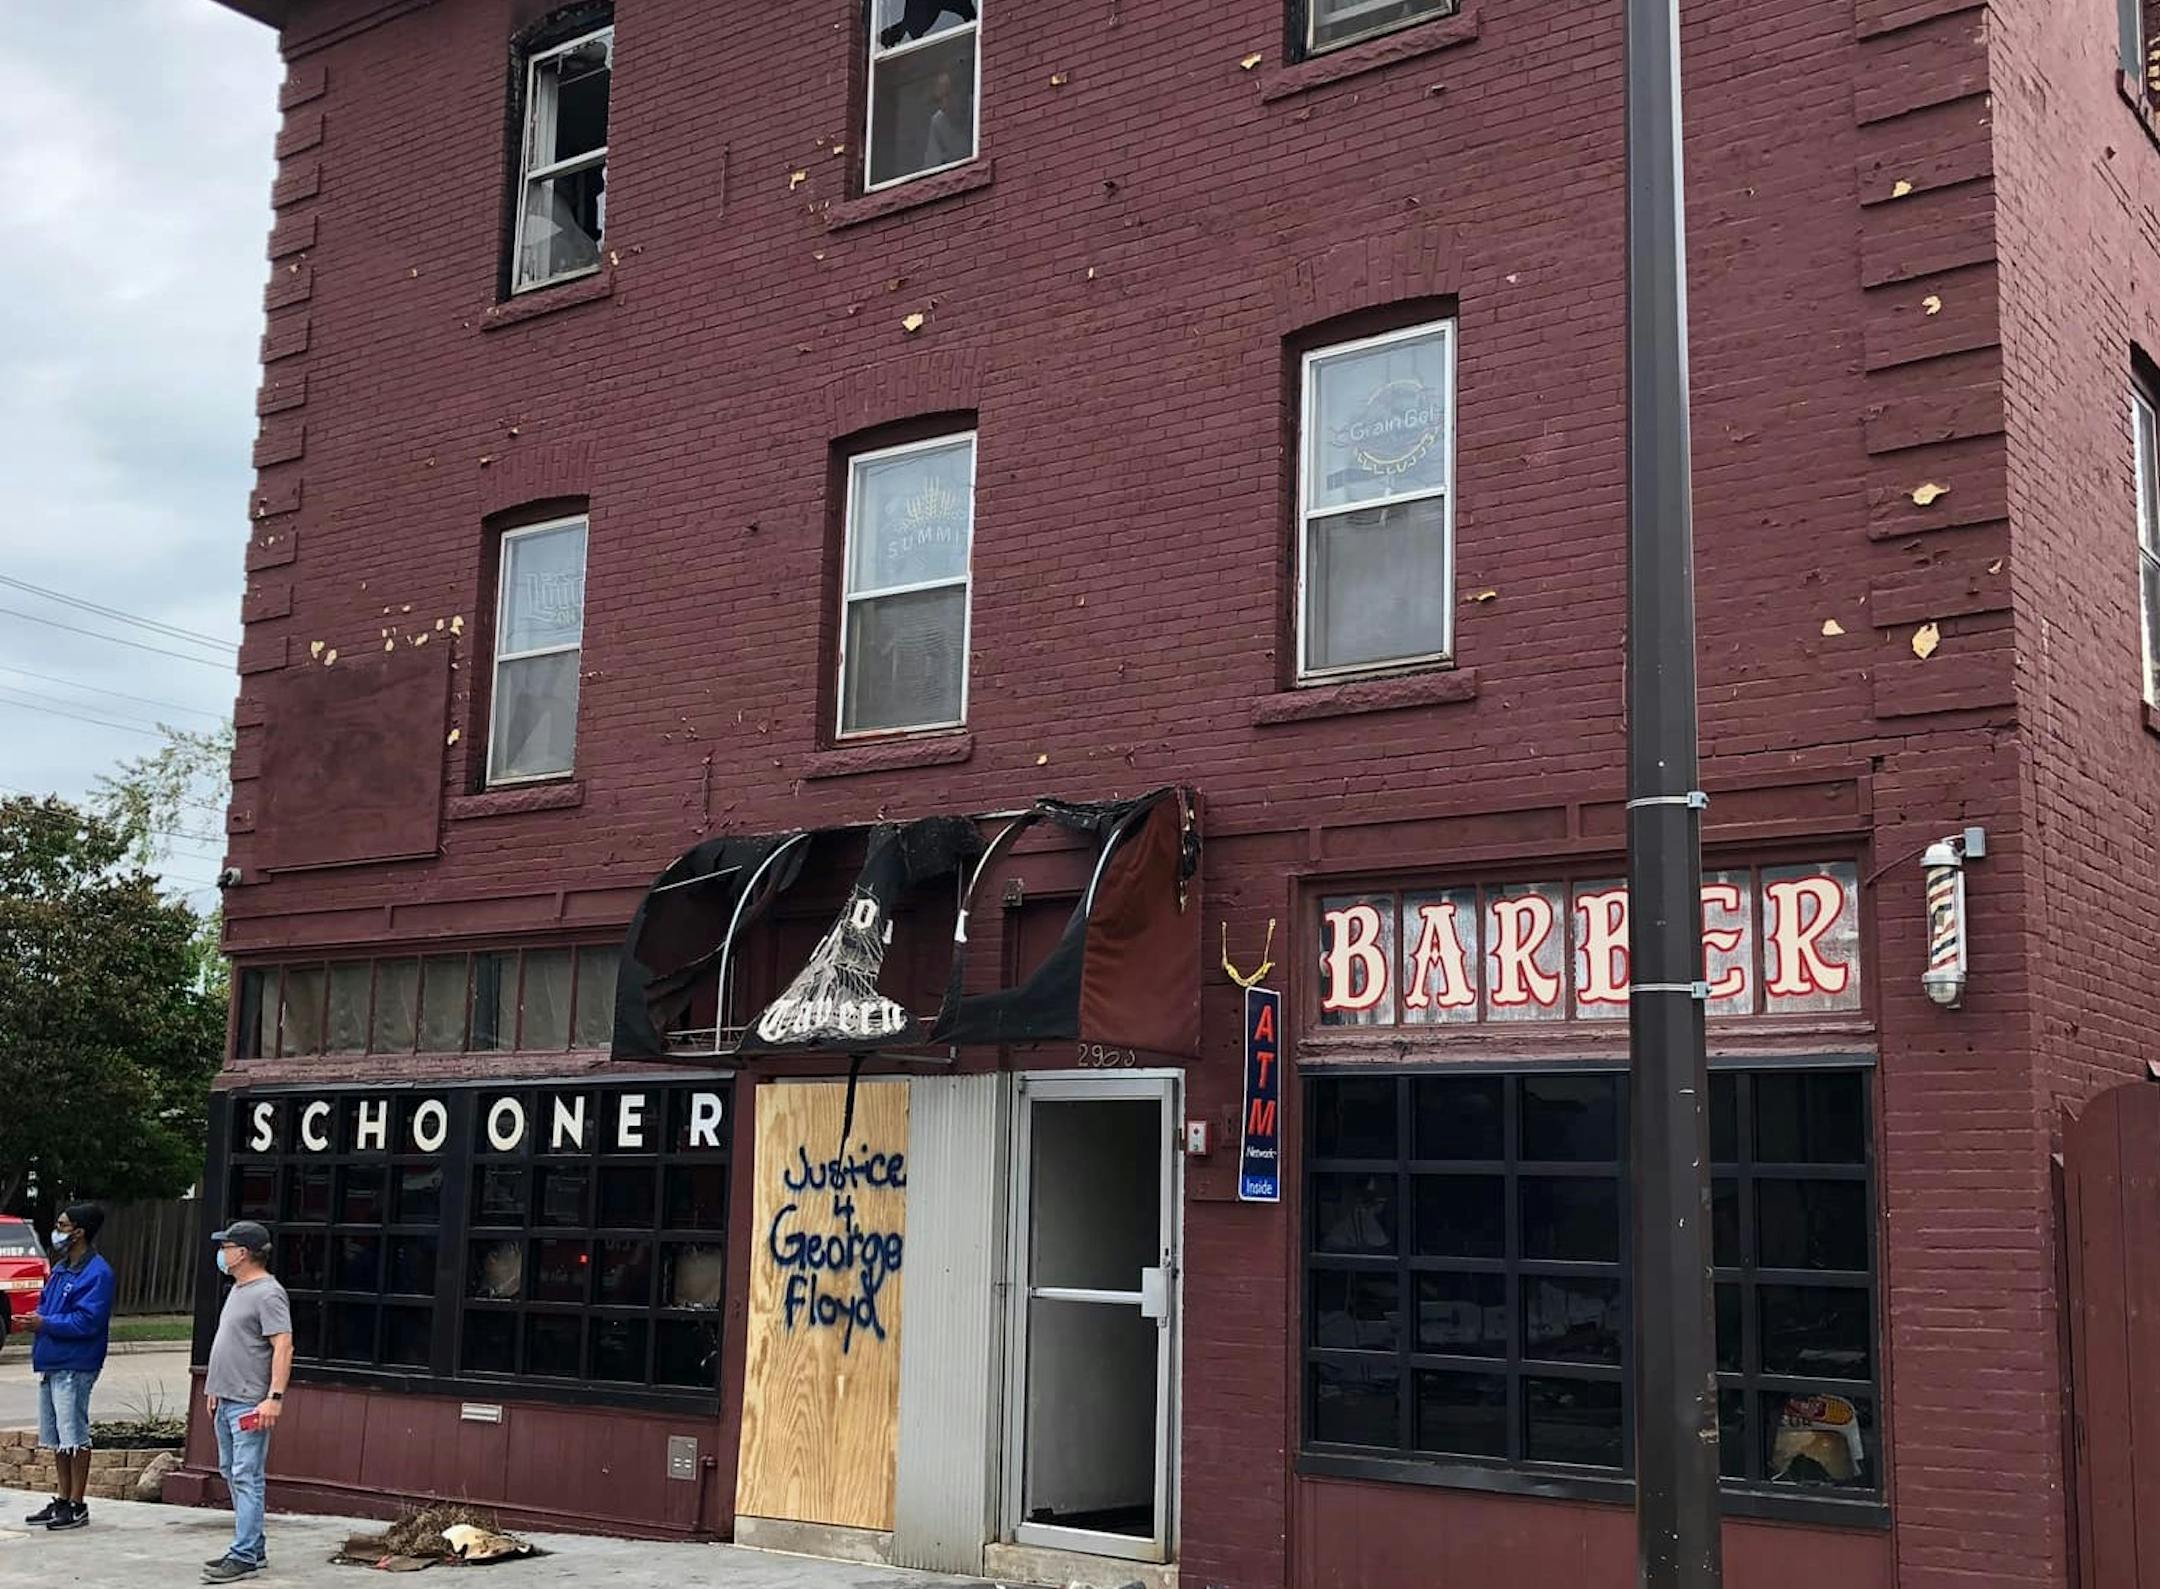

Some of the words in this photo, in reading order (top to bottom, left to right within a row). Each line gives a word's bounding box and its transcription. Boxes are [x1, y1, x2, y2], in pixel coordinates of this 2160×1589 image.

[1321, 875, 1849, 1011] BARBER
[1249, 1004, 1277, 1137] ATM
[250, 1092, 724, 1153] SCHOONER
[784, 1145, 907, 1191] Justice
[1245, 1177, 1273, 1196] Inside
[770, 1203, 903, 1293] George
[833, 1195, 855, 1233] 4
[785, 1271, 885, 1353] Floyd
